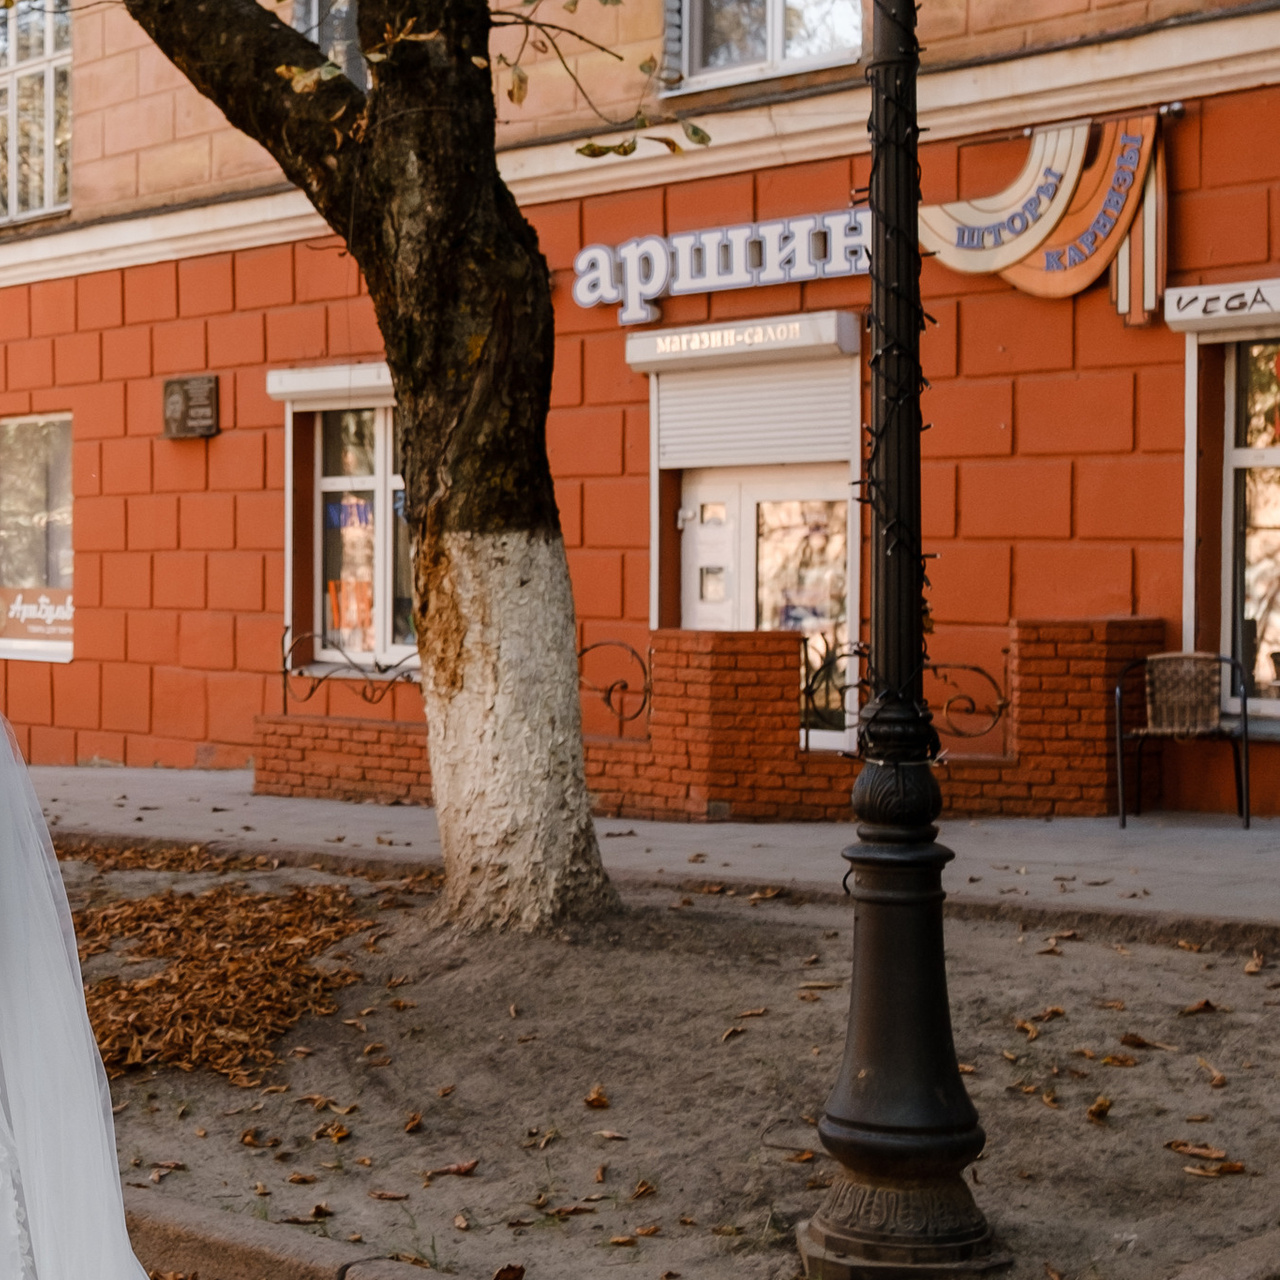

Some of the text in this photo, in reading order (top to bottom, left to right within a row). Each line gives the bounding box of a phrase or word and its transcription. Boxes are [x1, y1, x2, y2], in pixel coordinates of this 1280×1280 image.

[955, 167, 1063, 250] ШТОРЫ
[1044, 133, 1144, 272] КАРНИЗЫ
[573, 207, 872, 326] аршин
[1176, 287, 1275, 315] VEGA
[655, 321, 801, 354] магазин-салон
